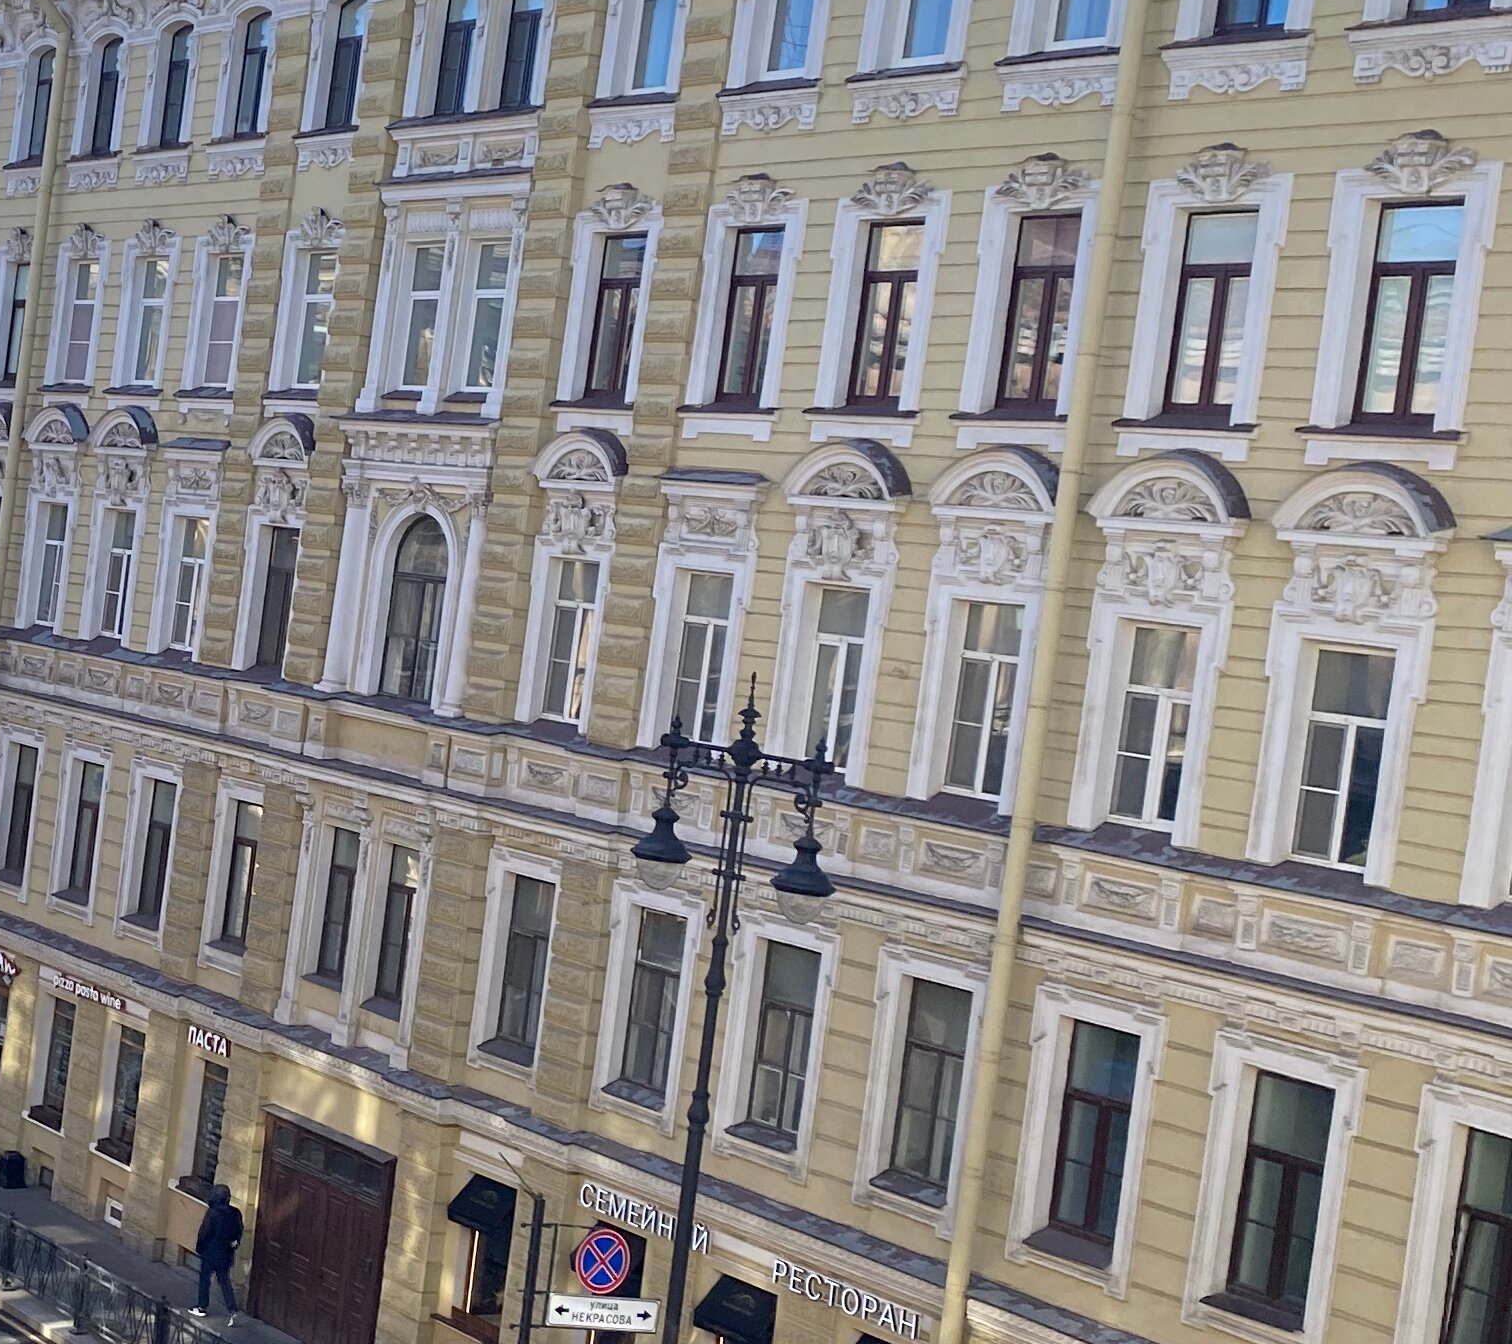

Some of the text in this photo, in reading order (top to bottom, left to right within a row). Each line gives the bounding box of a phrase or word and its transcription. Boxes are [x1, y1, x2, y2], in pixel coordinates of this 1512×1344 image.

[53, 974, 122, 1010] pizza pasta wine
[188, 1025, 227, 1058] ПАСТА
[579, 1183, 921, 1340] СЕМЕЙНЙ РЕСТОРАН
[571, 1312, 632, 1325] НЕКРАСОВА
[590, 1301, 619, 1311] улица
